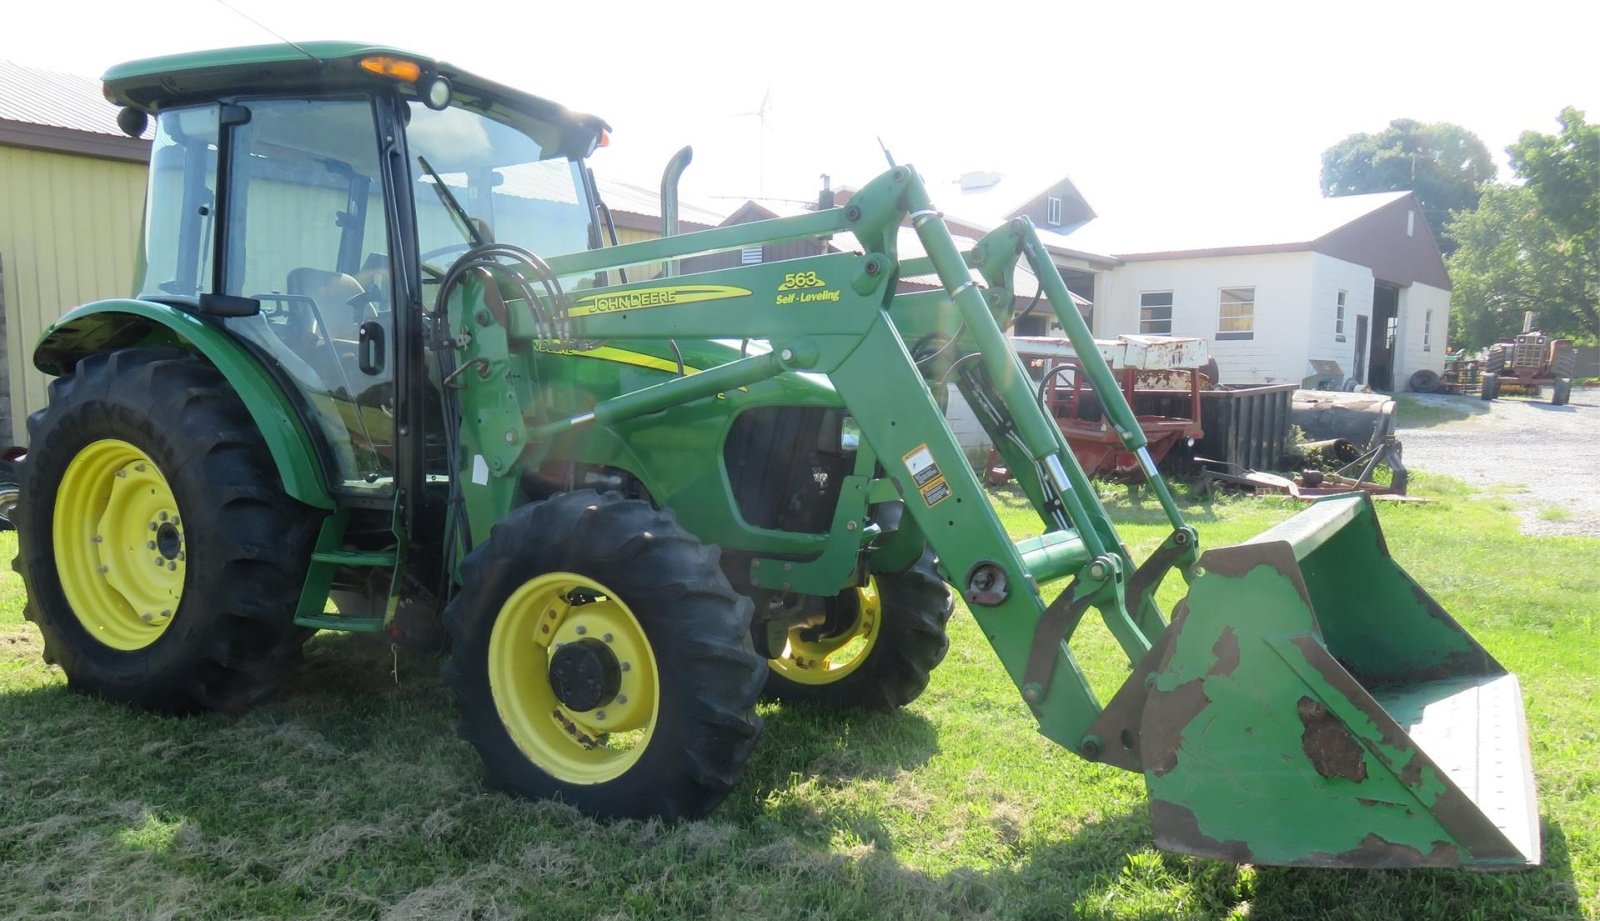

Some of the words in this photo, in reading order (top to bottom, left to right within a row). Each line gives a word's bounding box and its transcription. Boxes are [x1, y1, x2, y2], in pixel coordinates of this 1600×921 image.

[785, 271, 817, 287] 563
[589, 296, 628, 313] JOHN
[630, 291, 676, 307] DEERE
